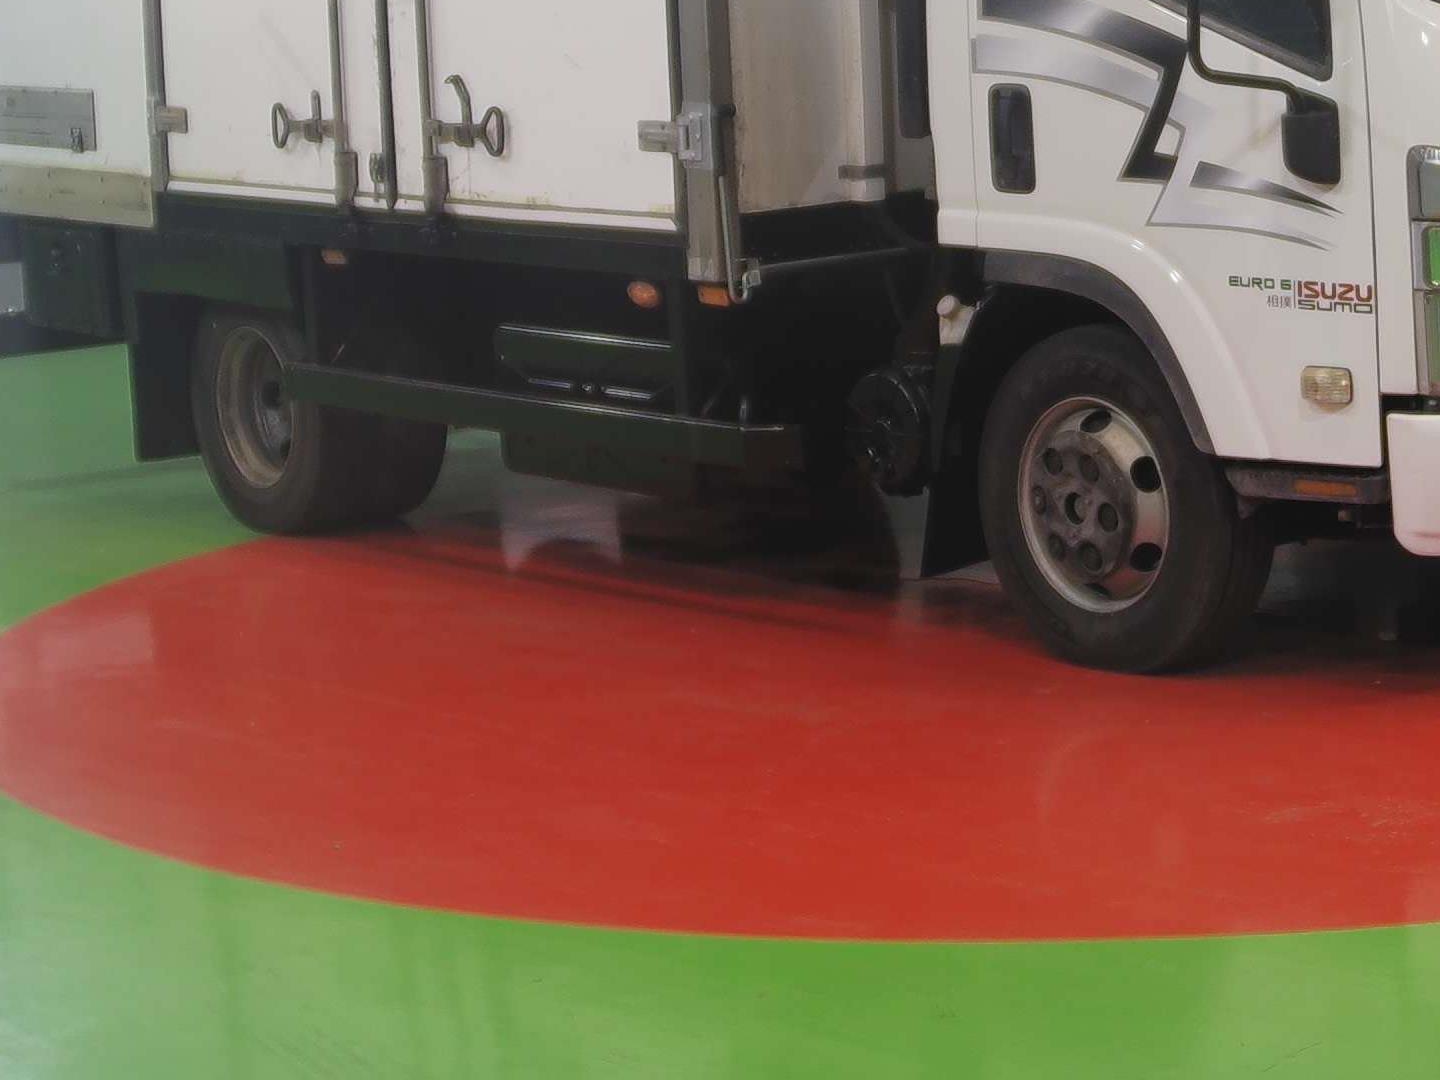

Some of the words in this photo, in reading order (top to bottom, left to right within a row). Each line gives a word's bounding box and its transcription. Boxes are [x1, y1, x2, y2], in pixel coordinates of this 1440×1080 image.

[1228, 275, 1276, 291] EURO
[1280, 279, 1293, 291] 6
[1297, 280, 1373, 302] ISUZU
[1297, 299, 1374, 315] SUMO
